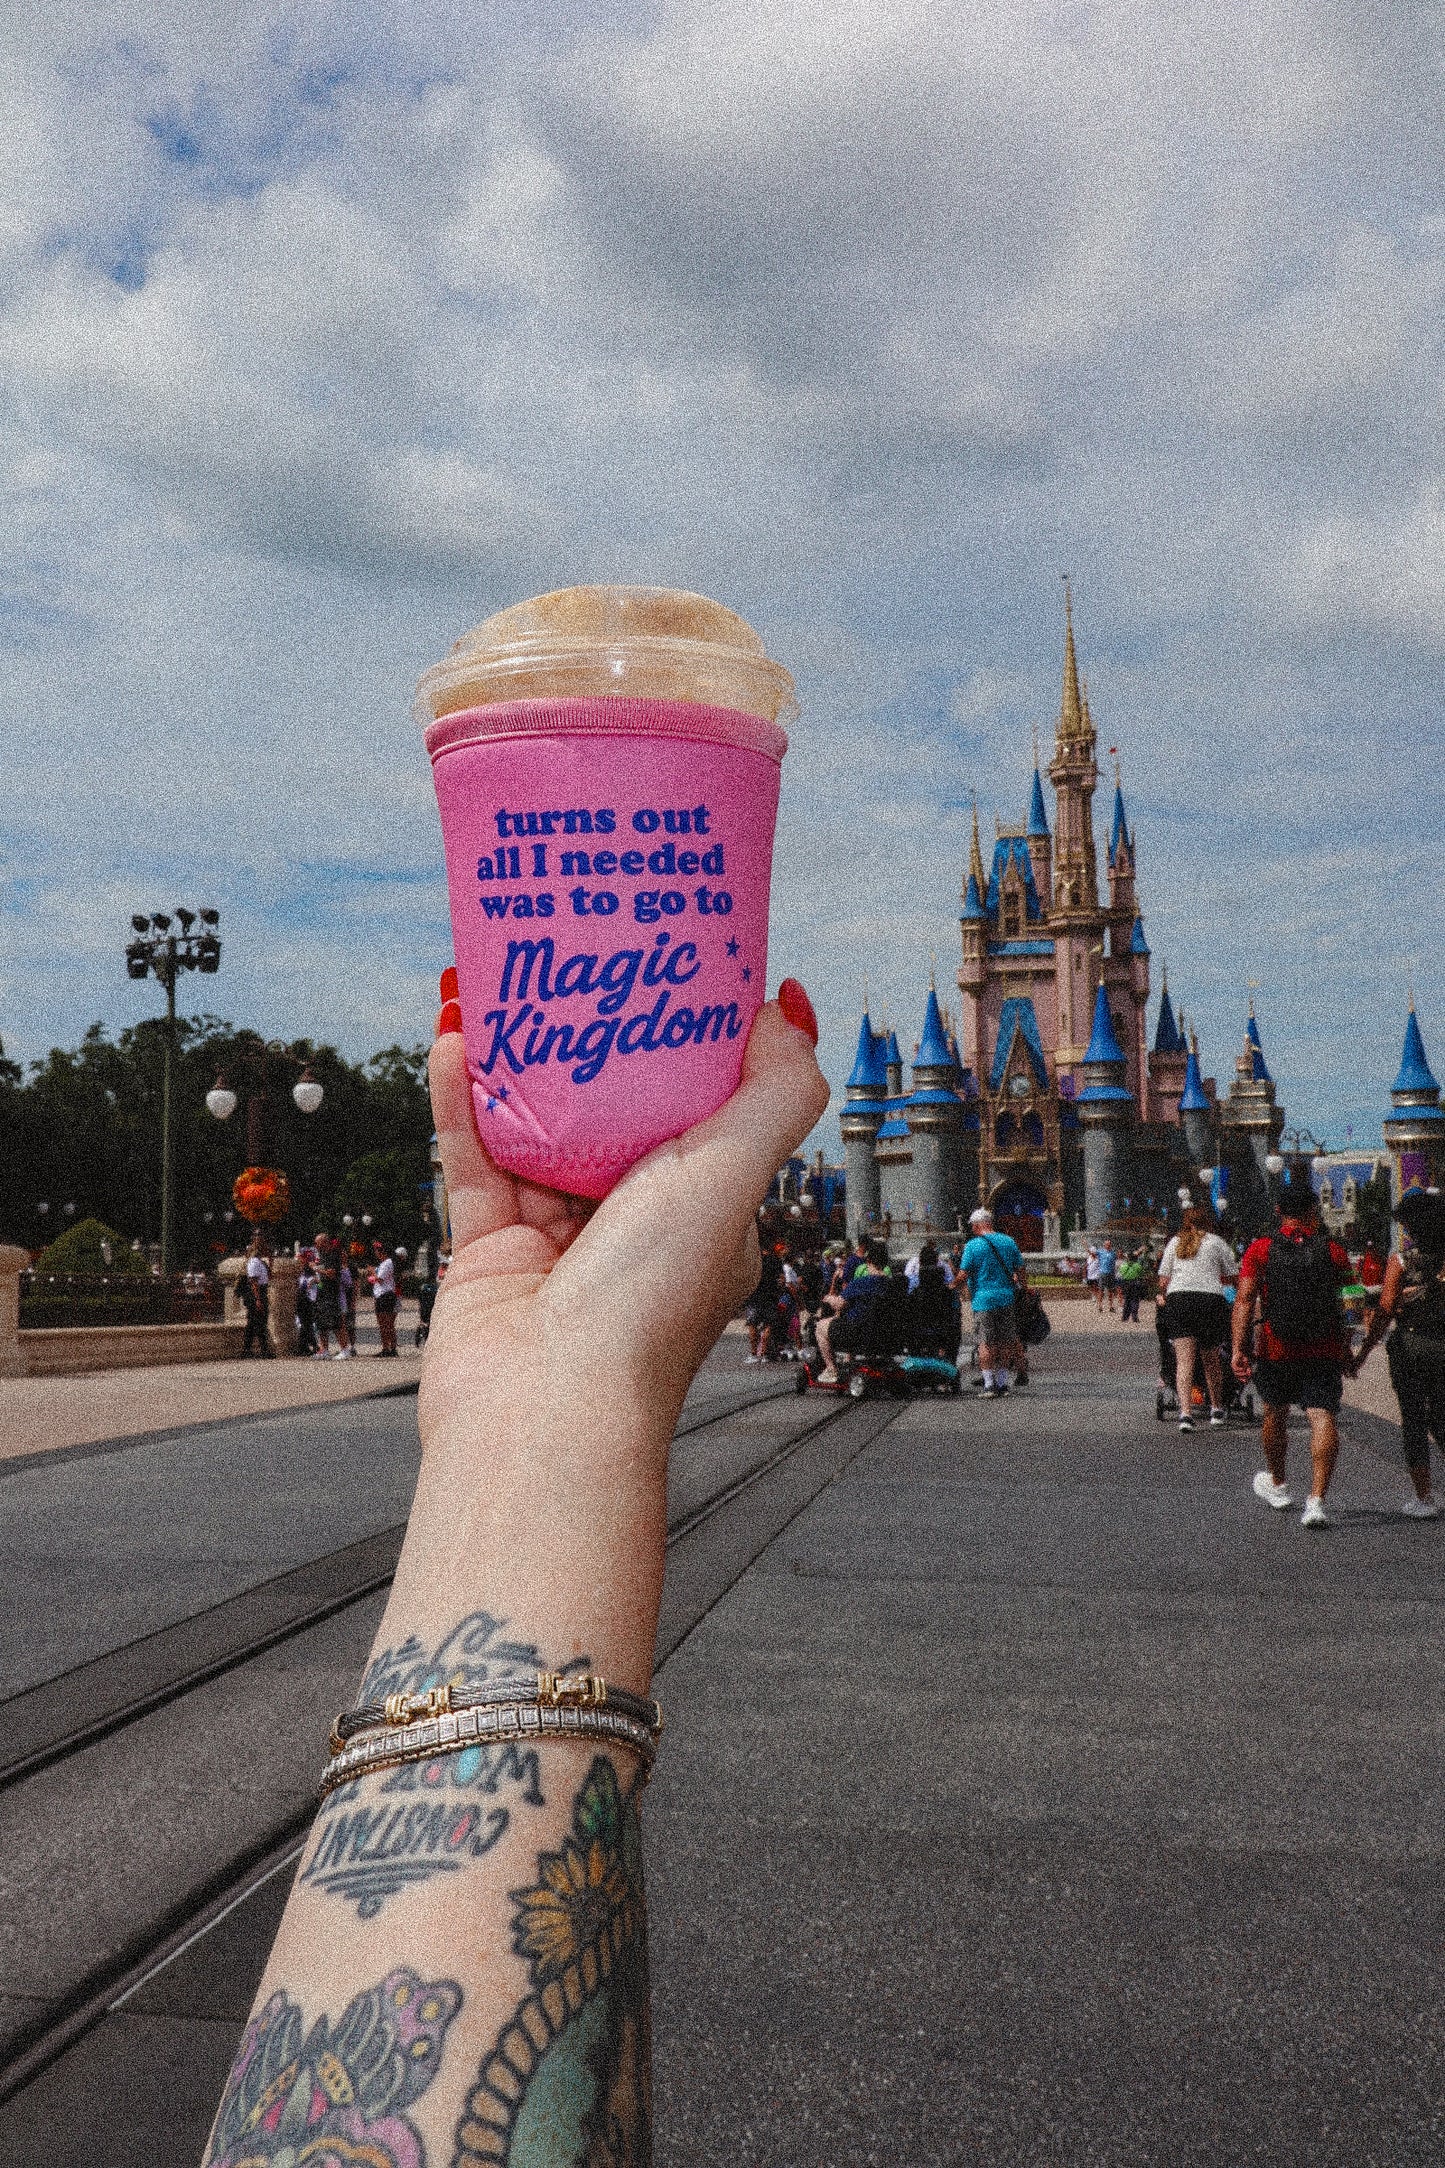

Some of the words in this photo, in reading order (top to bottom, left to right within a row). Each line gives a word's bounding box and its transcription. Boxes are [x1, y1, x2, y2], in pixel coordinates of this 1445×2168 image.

[495, 808, 617, 838] turns
[632, 804, 711, 835] out
[477, 845, 521, 880] all
[532, 843, 548, 878] I
[560, 842, 725, 876] needed
[480, 893, 555, 919] was
[569, 886, 620, 916] to
[634, 889, 687, 924] go
[694, 886, 733, 915] to
[498, 931, 700, 1014] Magic
[478, 990, 742, 1084] Kingdom
